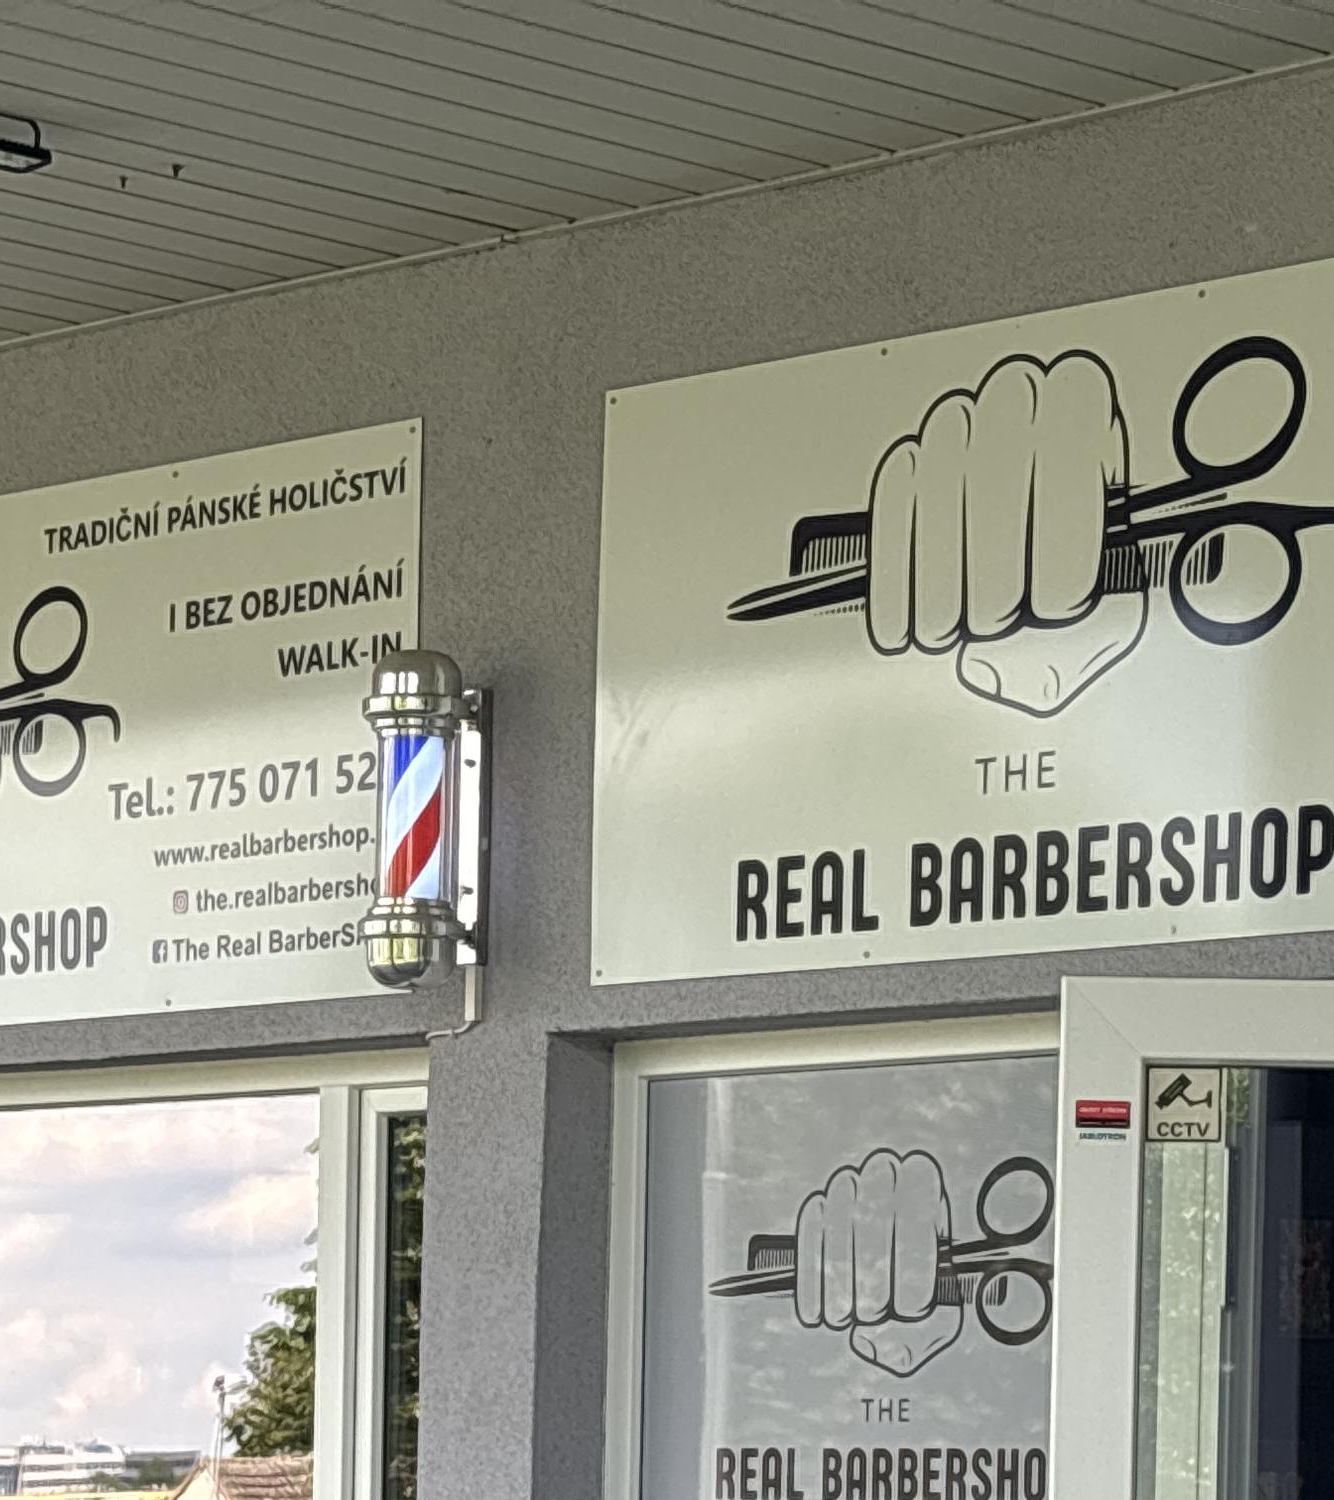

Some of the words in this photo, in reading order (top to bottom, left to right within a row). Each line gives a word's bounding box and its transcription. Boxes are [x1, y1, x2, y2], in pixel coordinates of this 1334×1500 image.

[45, 502, 160, 553] TRADIČNÍ
[168, 484, 262, 533] PÁNSKÉ
[269, 458, 407, 517] HOLIČSTVÍ
[169, 604, 176, 632] I
[185, 595, 233, 630] BEZ
[241, 559, 403, 621] OBJEDNÁNÍ
[277, 631, 402, 676] WALK-IN
[108, 780, 175, 821] Tel.:
[187, 770, 246, 809] 775
[259, 760, 319, 802] 071
[335, 751, 377, 794] 52
[975, 750, 1057, 795] THE
[154, 826, 375, 867] www.realbarbershop.
[736, 848, 879, 943] REAL
[172, 938, 210, 963] The
[216, 932, 262, 960] Real
[1157, 1122, 1209, 1137] CCTV
[861, 1398, 910, 1423] THE
[715, 1448, 804, 1500] REAL
